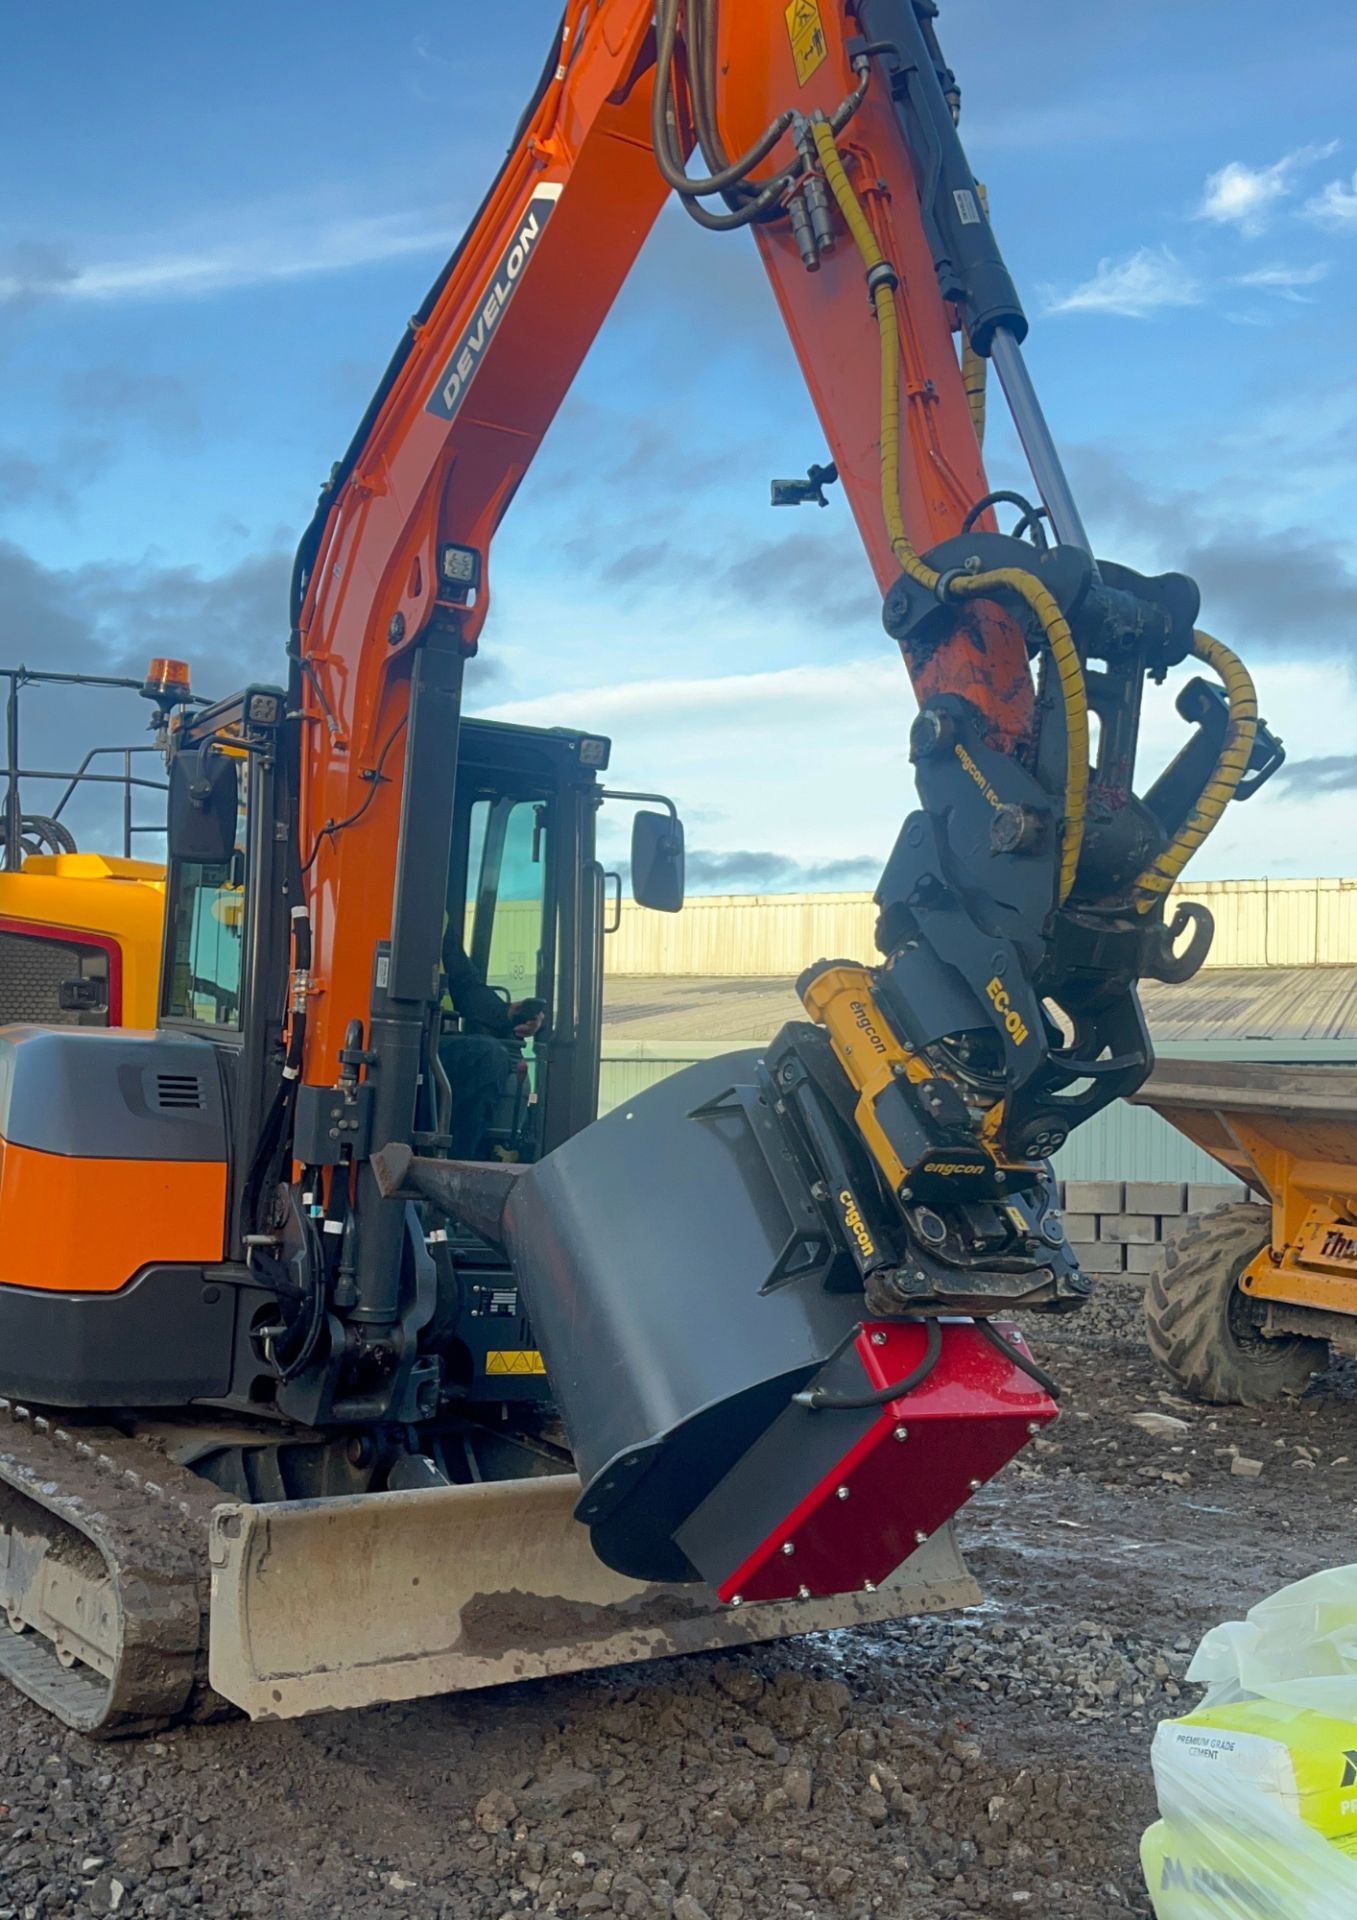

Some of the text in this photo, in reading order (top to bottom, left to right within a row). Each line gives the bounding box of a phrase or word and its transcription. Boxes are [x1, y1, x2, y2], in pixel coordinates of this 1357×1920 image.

[442, 212, 540, 411] DEVELON
[954, 743, 986, 790] engcon
[849, 1000, 888, 1055] engcon
[923, 1161, 986, 1176] engcon
[838, 1190, 875, 1258] engcon
[1176, 1734, 1236, 1752] PREMIUM GRADE
[1188, 1746, 1219, 1760] CEMENT
